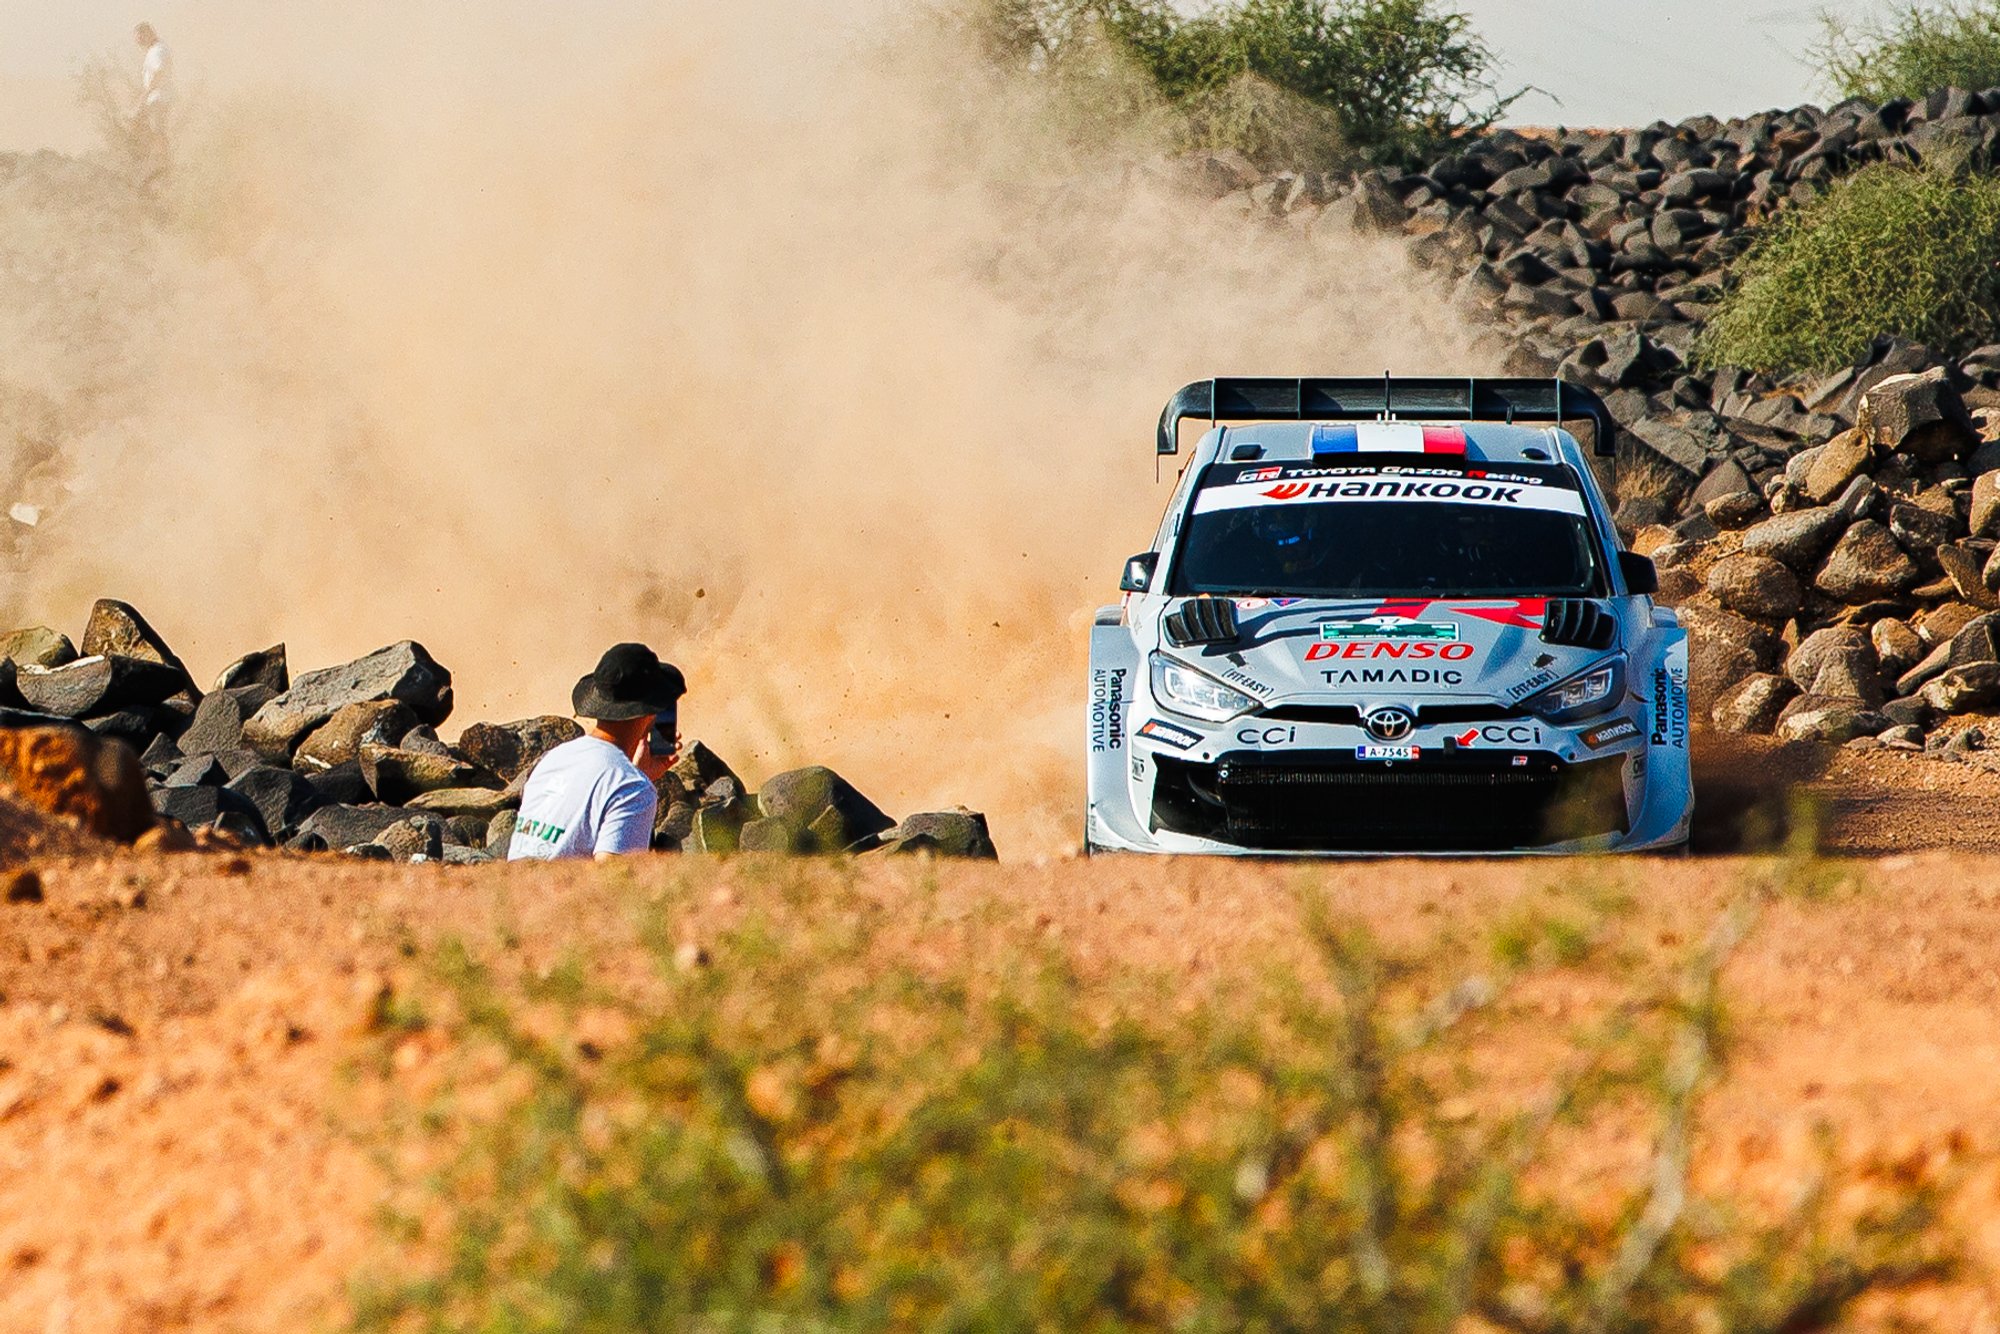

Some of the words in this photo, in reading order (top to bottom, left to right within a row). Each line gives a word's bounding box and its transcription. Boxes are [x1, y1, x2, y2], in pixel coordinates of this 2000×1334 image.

[1238, 467, 1282, 482] GR
[1287, 467, 1376, 477] TOYOTA
[1381, 466, 1463, 477] GAZOO
[1304, 642, 1474, 661] DENSO
[1321, 670, 1462, 684] TAMADIC
[1092, 668, 1106, 752] AUTOMOTIVE
[1109, 668, 1127, 750] Panasonic
[1650, 667, 1667, 746] Panasonic
[1671, 667, 1684, 749] AUTOMOTIVE
